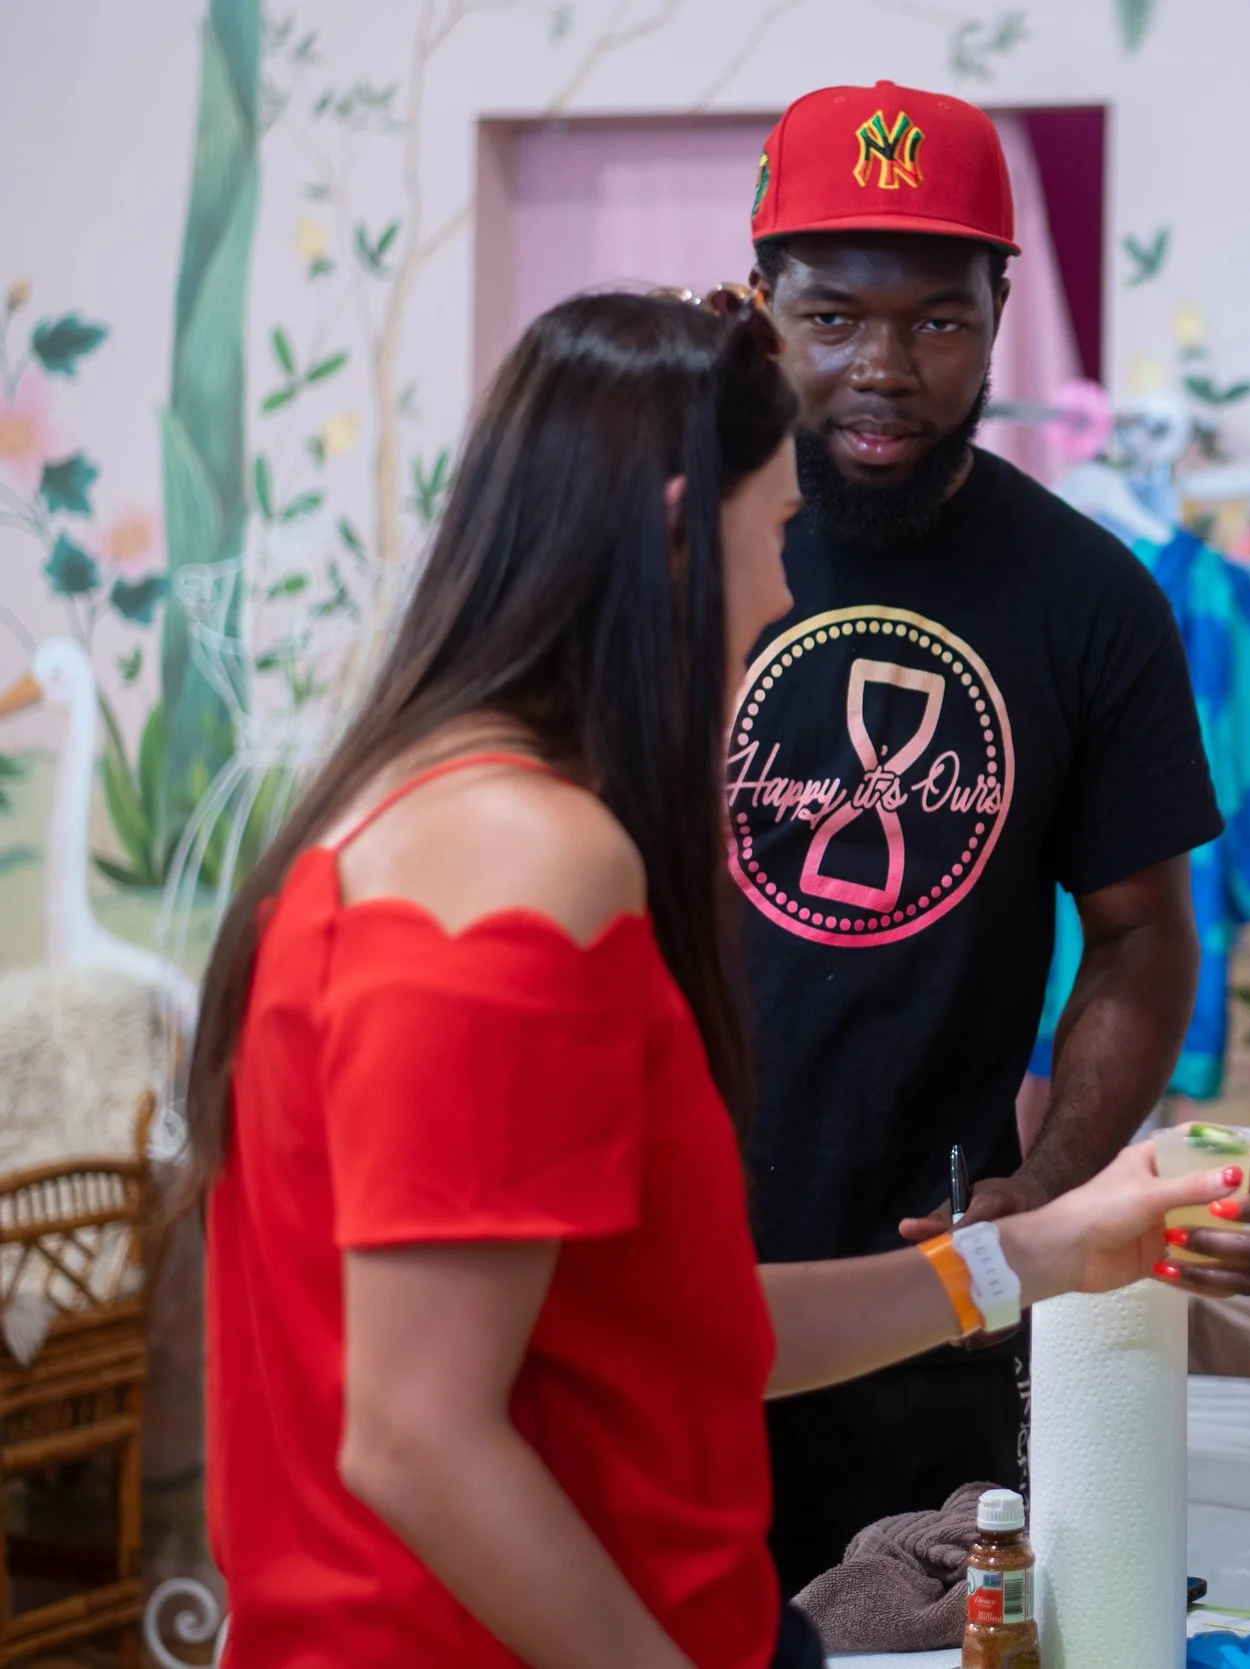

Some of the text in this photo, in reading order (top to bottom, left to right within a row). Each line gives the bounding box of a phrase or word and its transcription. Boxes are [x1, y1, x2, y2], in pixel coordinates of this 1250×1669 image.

[852, 109, 926, 190] NY
[725, 740, 848, 830] Happy
[911, 750, 1001, 815] Ours
